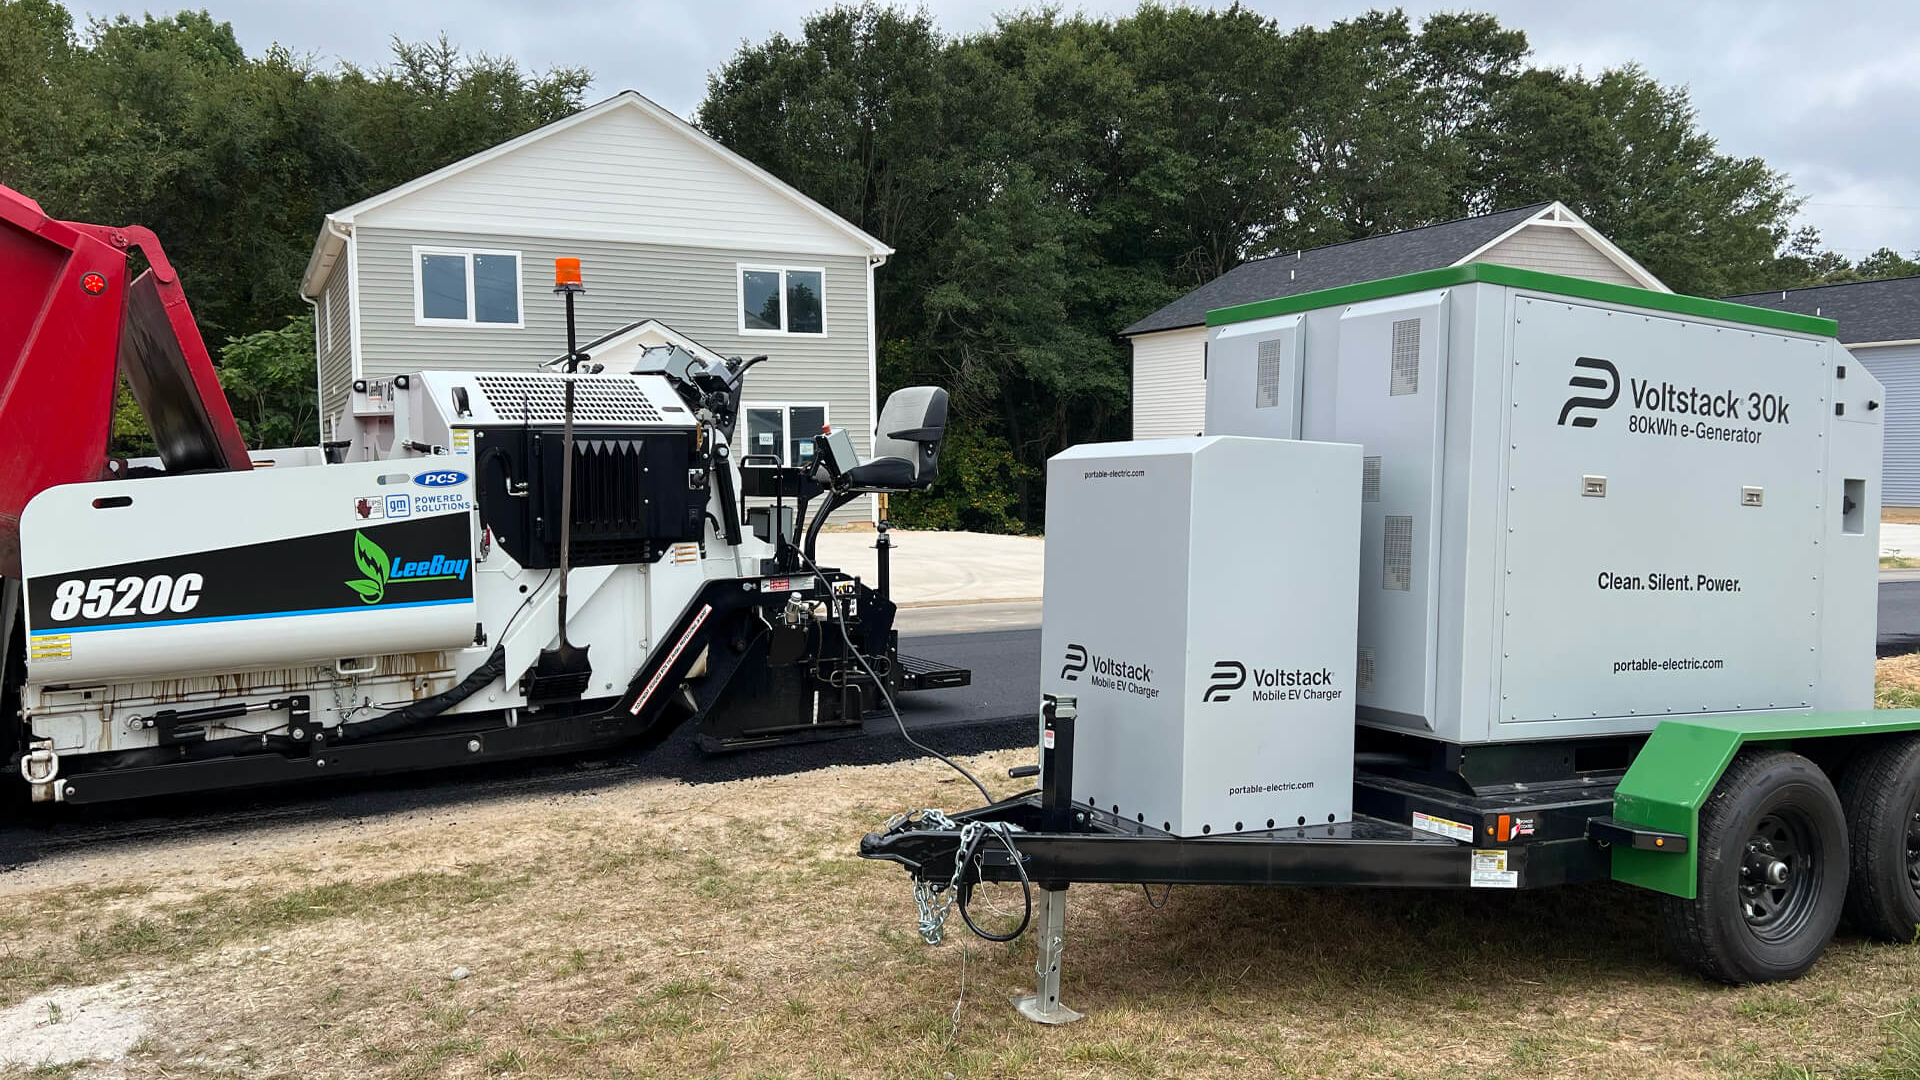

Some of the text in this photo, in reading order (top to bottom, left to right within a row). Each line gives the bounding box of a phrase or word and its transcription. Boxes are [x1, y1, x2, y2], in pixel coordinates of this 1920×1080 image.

[1631, 378, 1790, 424] Voltstack 30k
[1629, 415, 1762, 444] 80kWh e-Generator
[424, 473, 458, 485] PCS
[1084, 469, 1145, 480] portable-electric.com
[390, 500, 406, 512] gm
[414, 494, 463, 504] POWERED
[415, 501, 471, 513] SOLUTIONS
[389, 554, 470, 580] LeeBoy
[1598, 572, 1741, 592] Clean. Silent. Power.
[50, 572, 204, 622] 8520C
[1092, 655, 1151, 682] Voltstack
[1613, 657, 1724, 674] portable-electric.com
[1253, 668, 1332, 687] Voltstack
[1091, 675, 1159, 699] Mobile EV Charger
[1252, 689, 1342, 701] Mobile EV Charger
[1229, 781, 1314, 796] portable-electric.com
